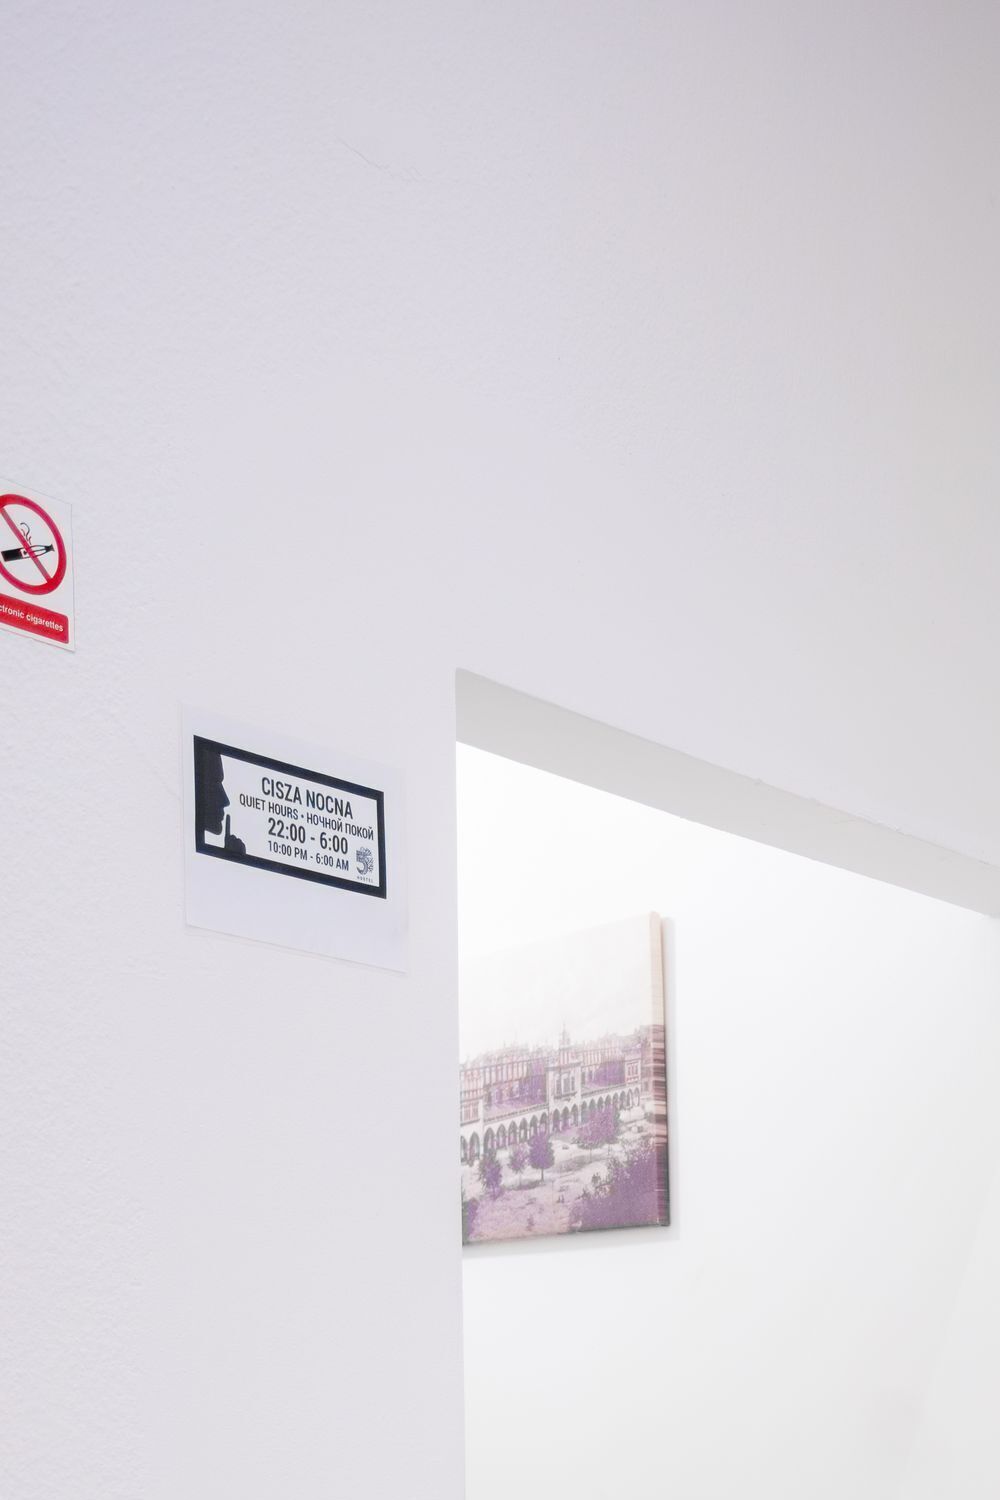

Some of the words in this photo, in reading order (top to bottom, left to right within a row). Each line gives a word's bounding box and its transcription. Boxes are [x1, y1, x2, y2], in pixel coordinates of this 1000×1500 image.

[26, 615, 63, 631] cigarettes
[261, 776, 302, 805] CISZA
[306, 789, 353, 819] NOCNA
[239, 793, 265, 811] QUIET
[268, 802, 299, 821] HOURS
[306, 812, 343, 832] НОЧНОЙ
[345, 823, 374, 841] ПОКОЙ
[268, 818, 306, 844] 22:00
[319, 831, 349, 855] 6:00
[268, 840, 292, 856] 10:00
[294, 847, 308, 861] PM
[316, 852, 334, 867] 6:00
[335, 859, 349, 872] AM
